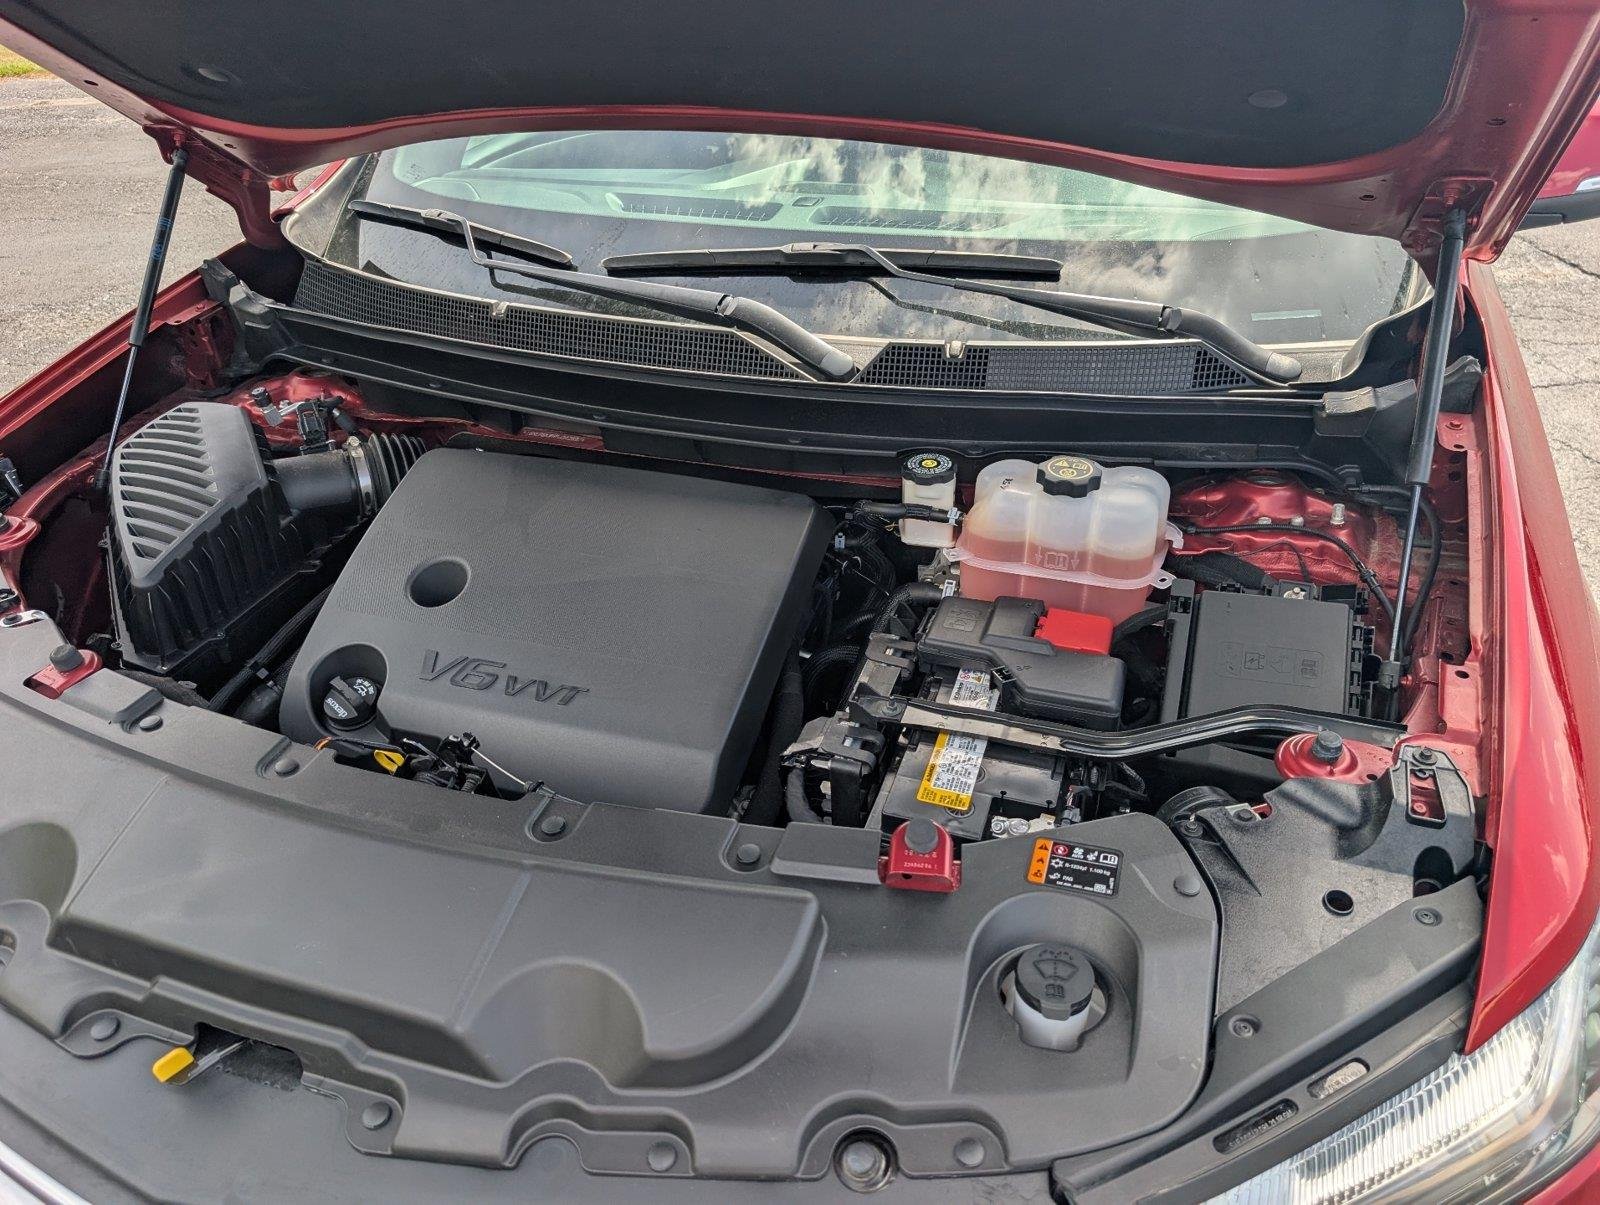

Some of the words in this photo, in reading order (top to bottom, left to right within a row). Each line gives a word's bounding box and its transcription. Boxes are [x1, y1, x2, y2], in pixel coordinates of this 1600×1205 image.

[419, 649, 507, 691] V6
[504, 674, 590, 706] VVT
[325, 697, 348, 718] dexos
